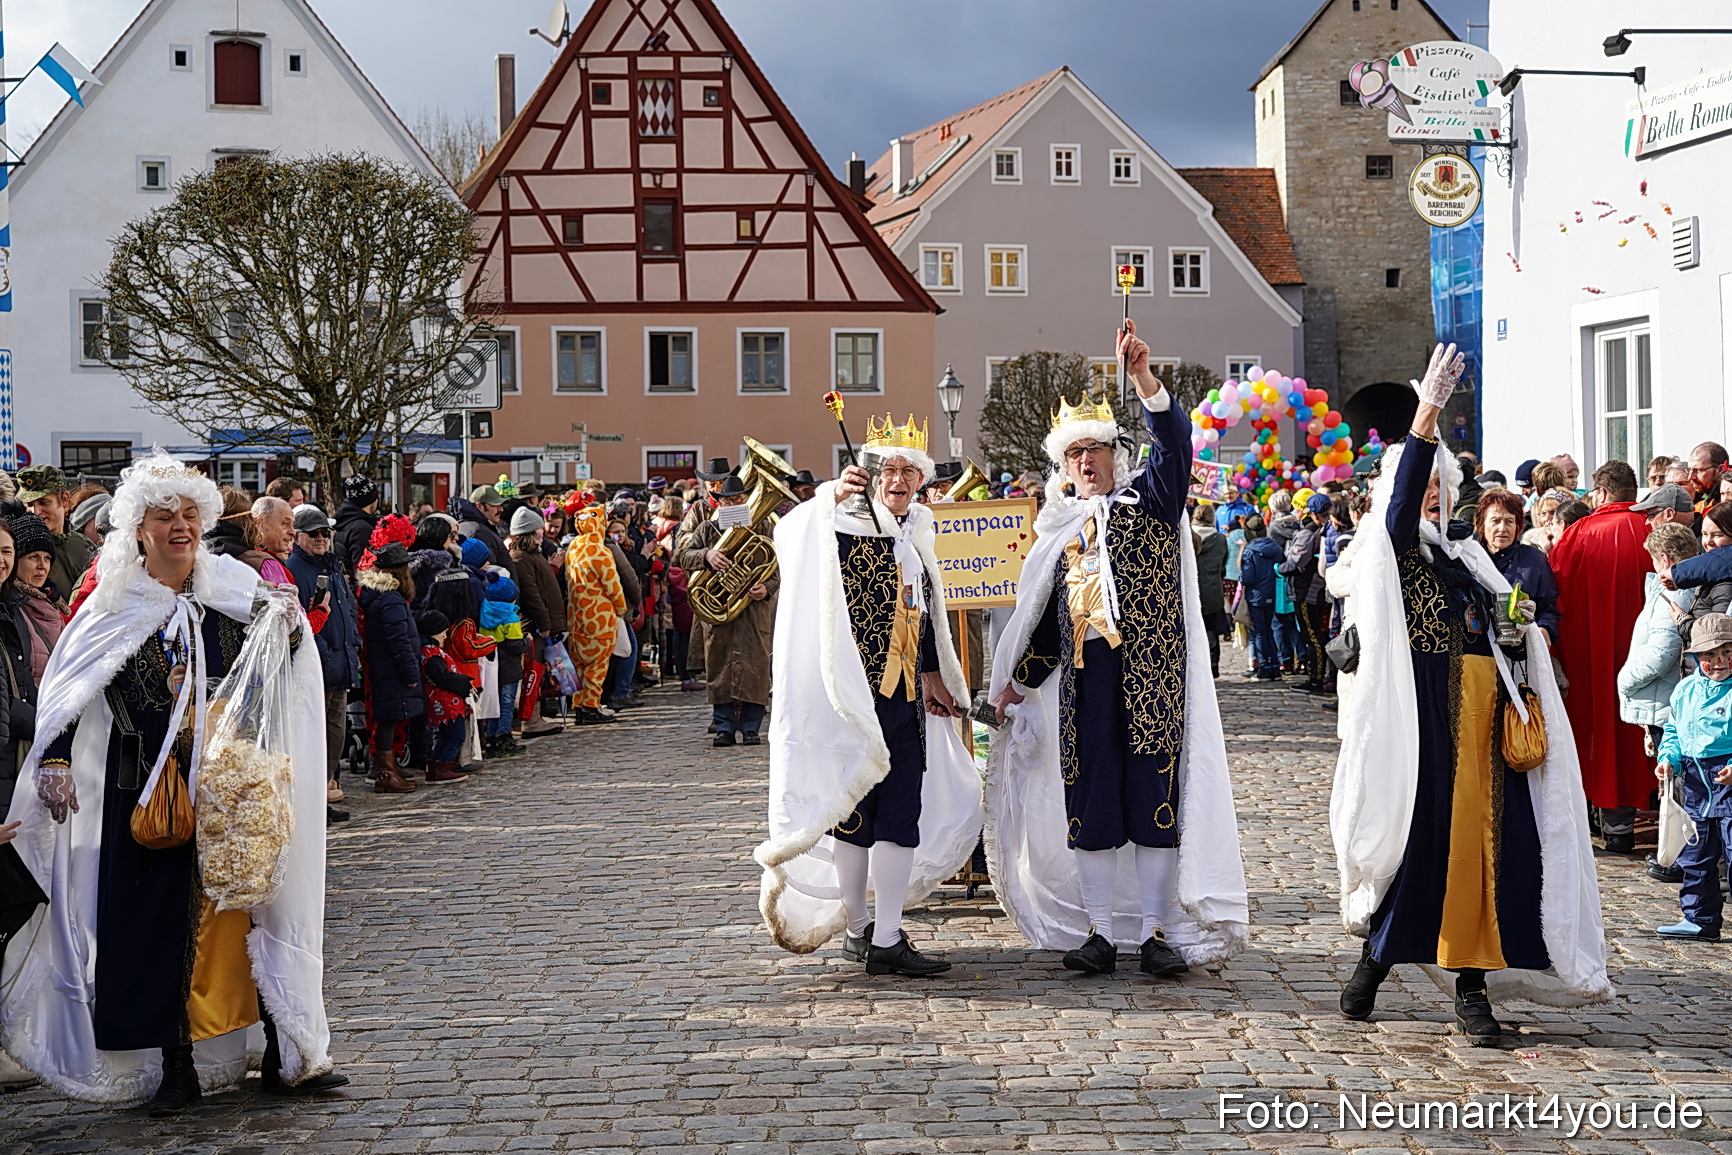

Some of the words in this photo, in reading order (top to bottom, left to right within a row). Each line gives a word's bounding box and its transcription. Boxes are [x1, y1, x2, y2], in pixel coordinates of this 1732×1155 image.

[1414, 46, 1474, 60] Pizzeria
[1429, 67, 1461, 81] Café
[1413, 84, 1475, 101] Eisdiele
[1423, 116, 1467, 126] Bella
[1646, 110, 1685, 144] Bella
[1690, 102, 1732, 131] Roma
[1394, 125, 1441, 135] Roma
[1434, 160, 1458, 168] WINKLER
[1429, 209, 1463, 217] BERCHING
